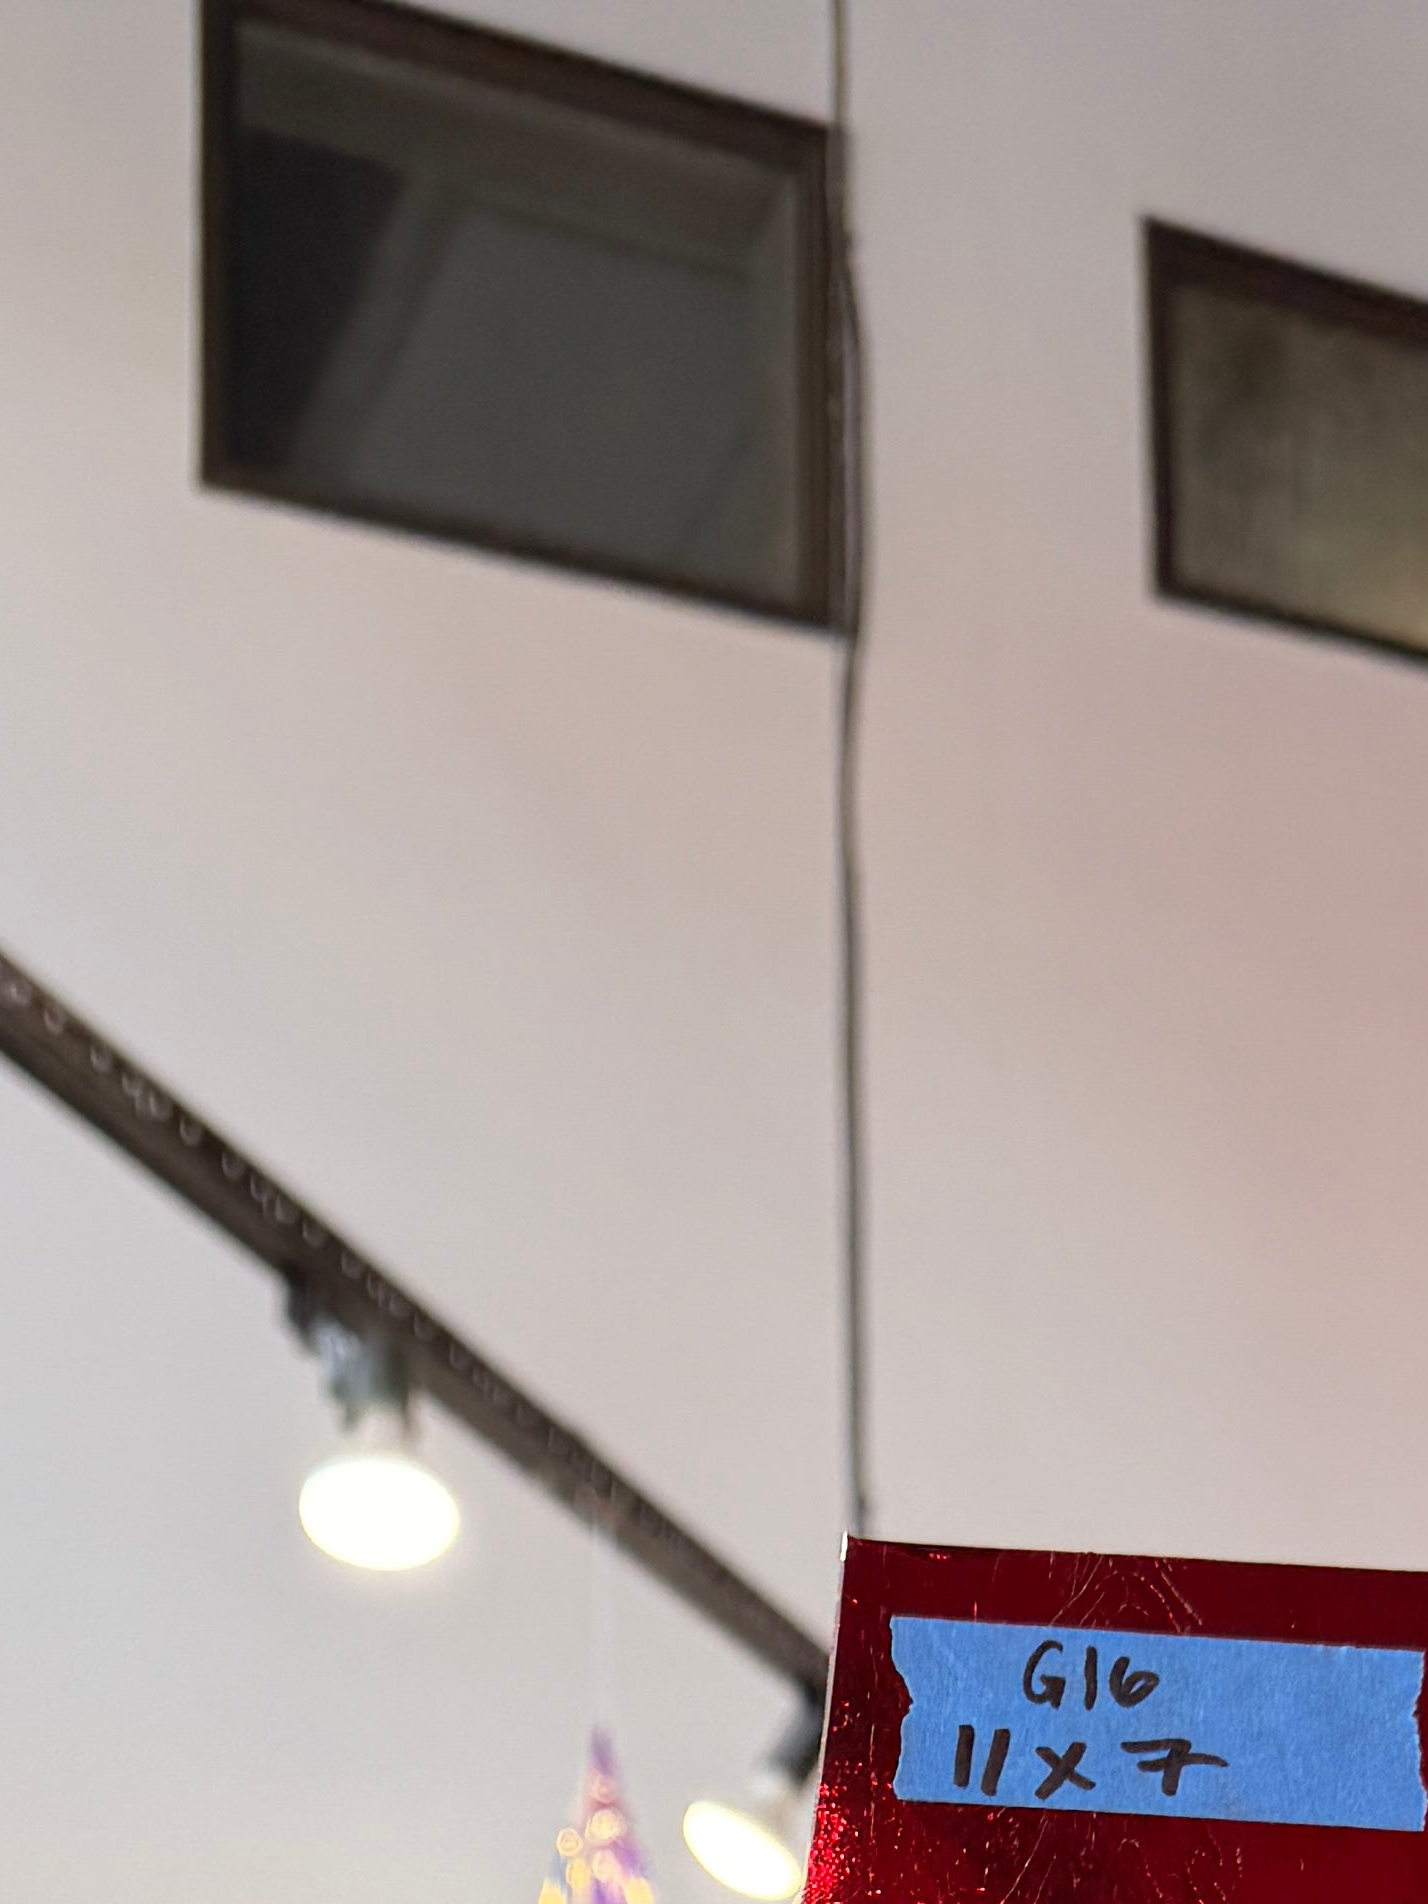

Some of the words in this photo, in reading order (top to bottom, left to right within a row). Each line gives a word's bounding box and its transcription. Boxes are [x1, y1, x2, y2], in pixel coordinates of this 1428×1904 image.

[1022, 1639, 1161, 1711] G16
[953, 1724, 1012, 1798] 11
[1120, 1737, 1229, 1797] 7
